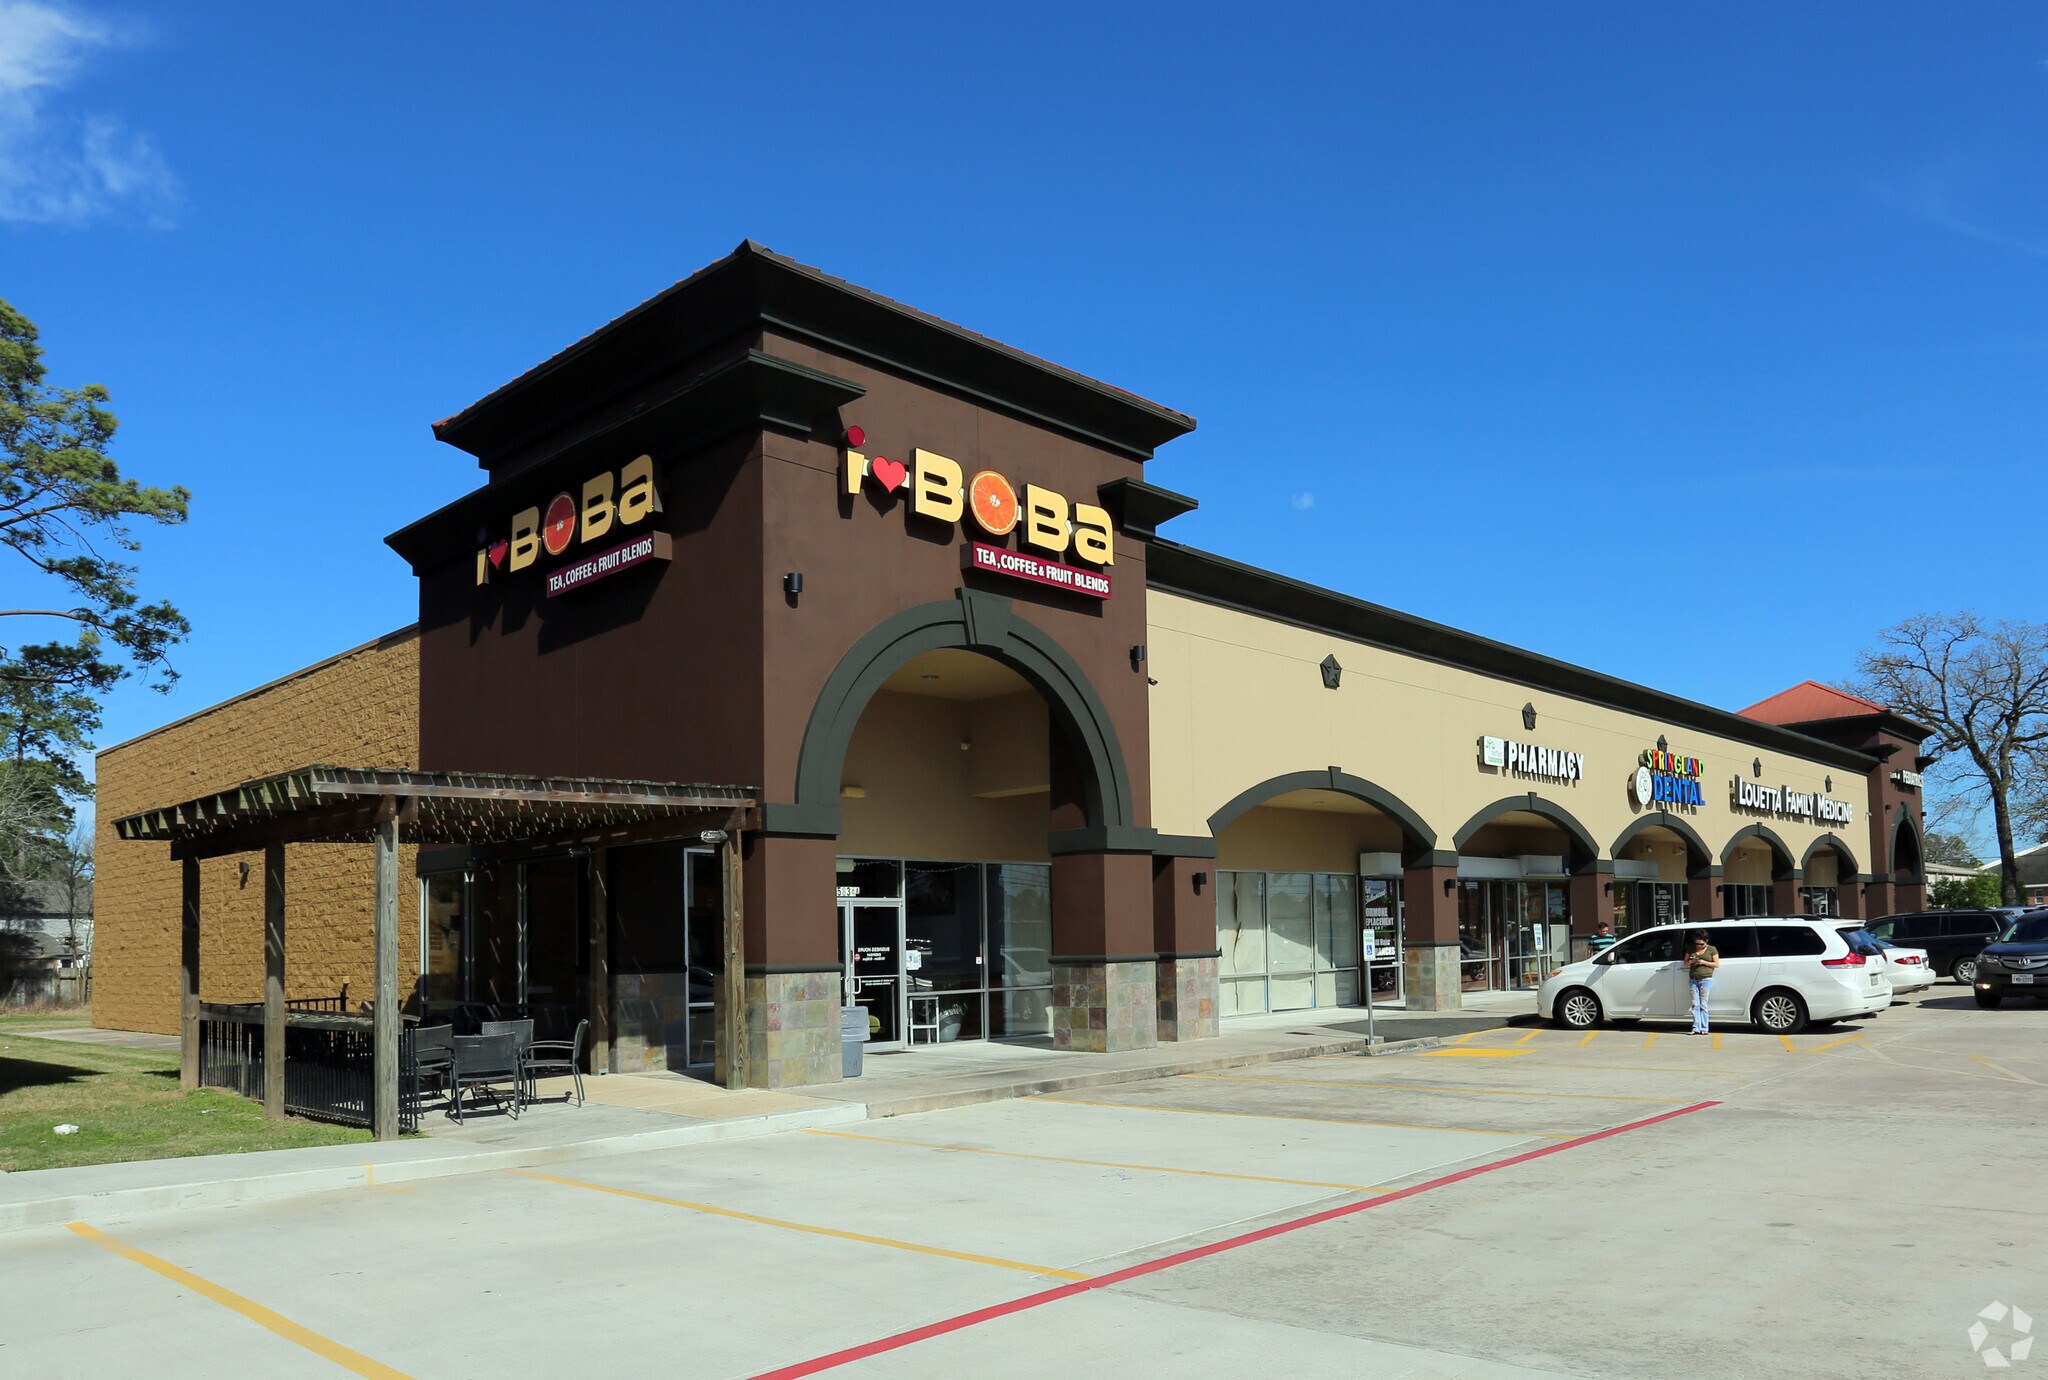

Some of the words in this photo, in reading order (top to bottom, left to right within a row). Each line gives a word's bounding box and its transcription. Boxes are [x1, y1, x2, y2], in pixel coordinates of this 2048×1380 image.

[565, 562, 593, 586] COFFEE
[592, 562, 598, 574] &
[598, 551, 621, 573] FRUIT
[621, 538, 652, 563] BLENDS
[1000, 554, 1038, 576] COFFEE
[1038, 565, 1045, 577] &
[1046, 565, 1073, 585] FRUIT
[1074, 572, 1109, 594] BLENDS
[1508, 740, 1585, 780] PHARMACY
[1646, 748, 1705, 777] SPRINGLAND
[1653, 774, 1706, 806] DENTAL
[1739, 776, 1783, 813] LOUETTA
[1785, 786, 1815, 816] FAMILY
[1817, 793, 1853, 822] MEDICINE
[1365, 907, 1388, 917] ORMONE
[1365, 917, 1394, 926] EPLACEMENT
